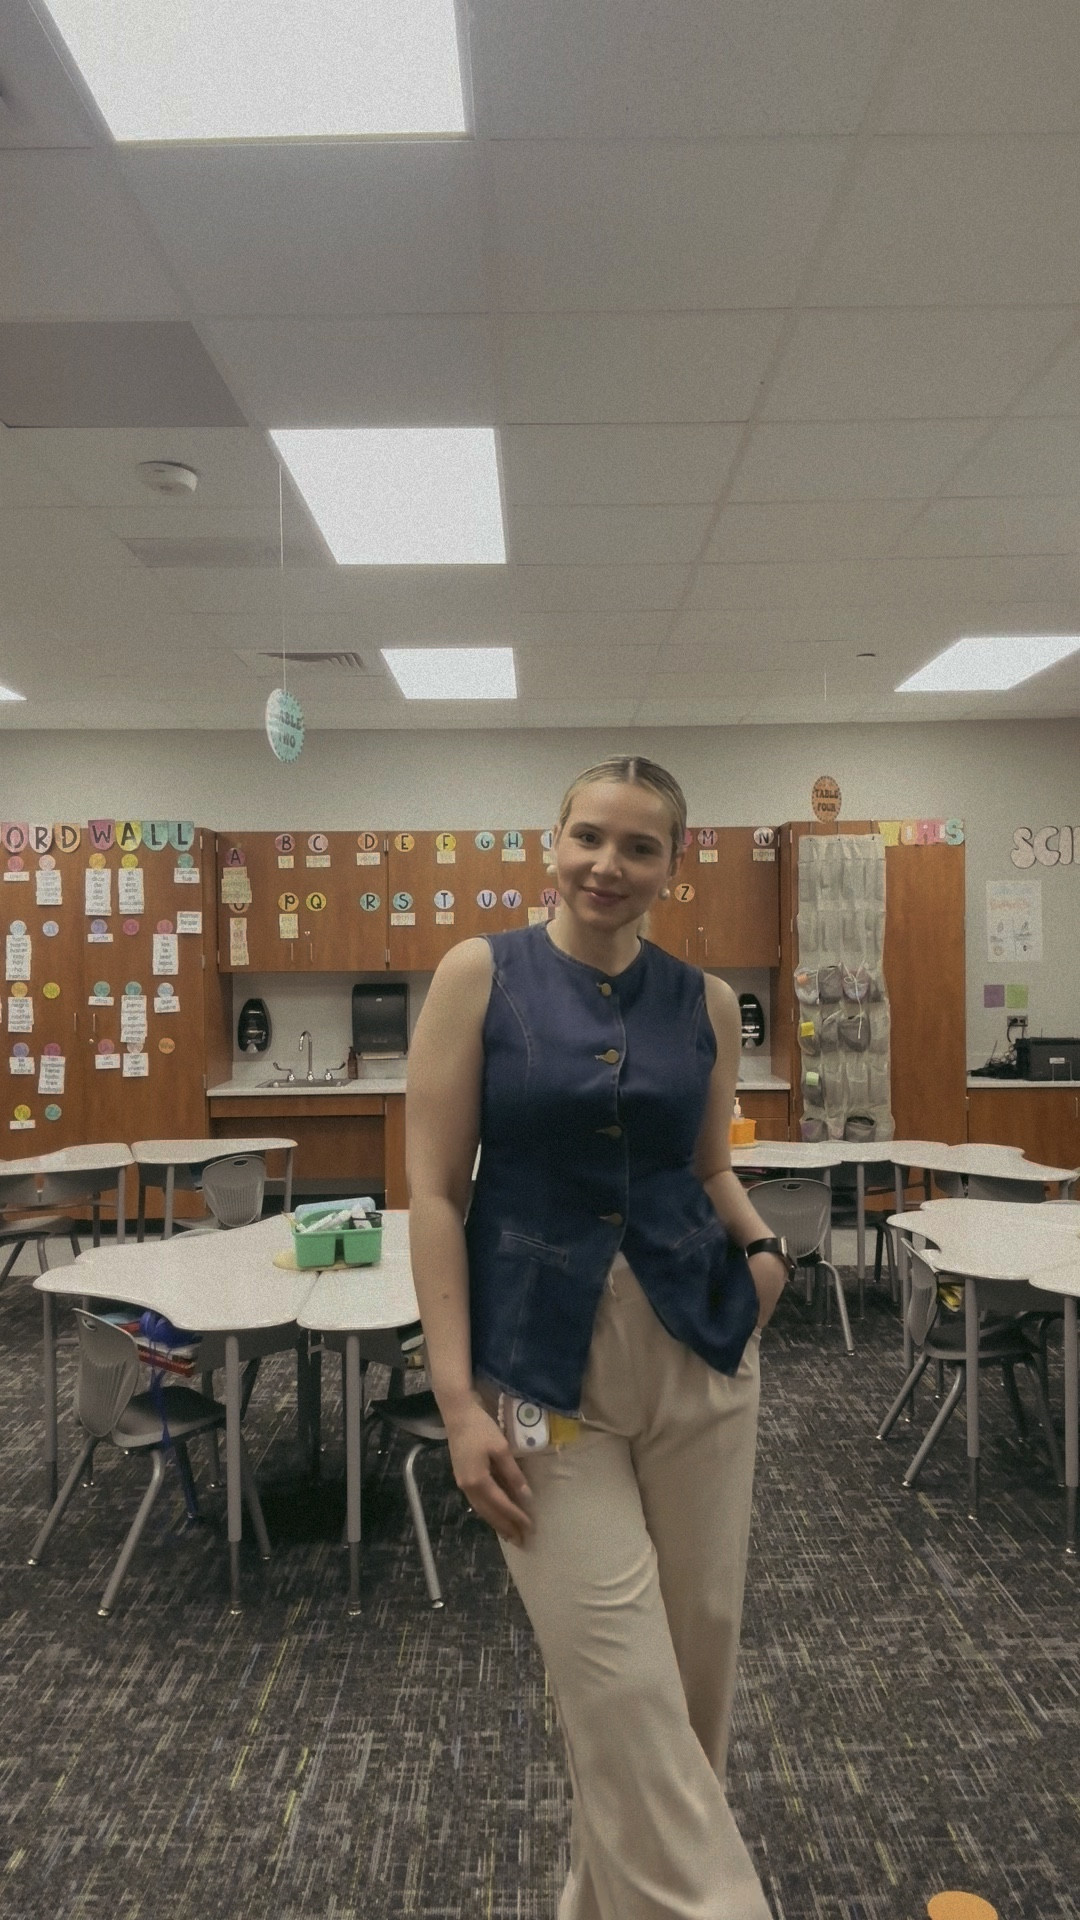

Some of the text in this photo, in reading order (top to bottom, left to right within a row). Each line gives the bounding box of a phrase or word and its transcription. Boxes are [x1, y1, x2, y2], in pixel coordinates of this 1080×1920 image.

[815, 789, 839, 799] TABLE
[817, 802, 837, 812] FOUR
[6, 821, 189, 850] ORD WALL
[282, 835, 292, 850] B
[313, 835, 323, 850] C
[364, 833, 375, 849] D
[401, 835, 409, 850] E
[442, 834, 450, 850] F
[481, 836, 490, 849] G
[508, 832, 519, 848] H
[702, 830, 714, 845] M
[759, 832, 769, 844] N
[230, 848, 241, 864] A
[440, 892, 449, 907] T
[481, 892, 492, 907] U
[507, 891, 518, 907] V
[543, 890, 557, 905] W
[681, 885, 690, 900] Z
[284, 894, 296, 910] P
[310, 894, 322, 909] Q
[366, 894, 376, 910] R
[398, 893, 409, 910] S
